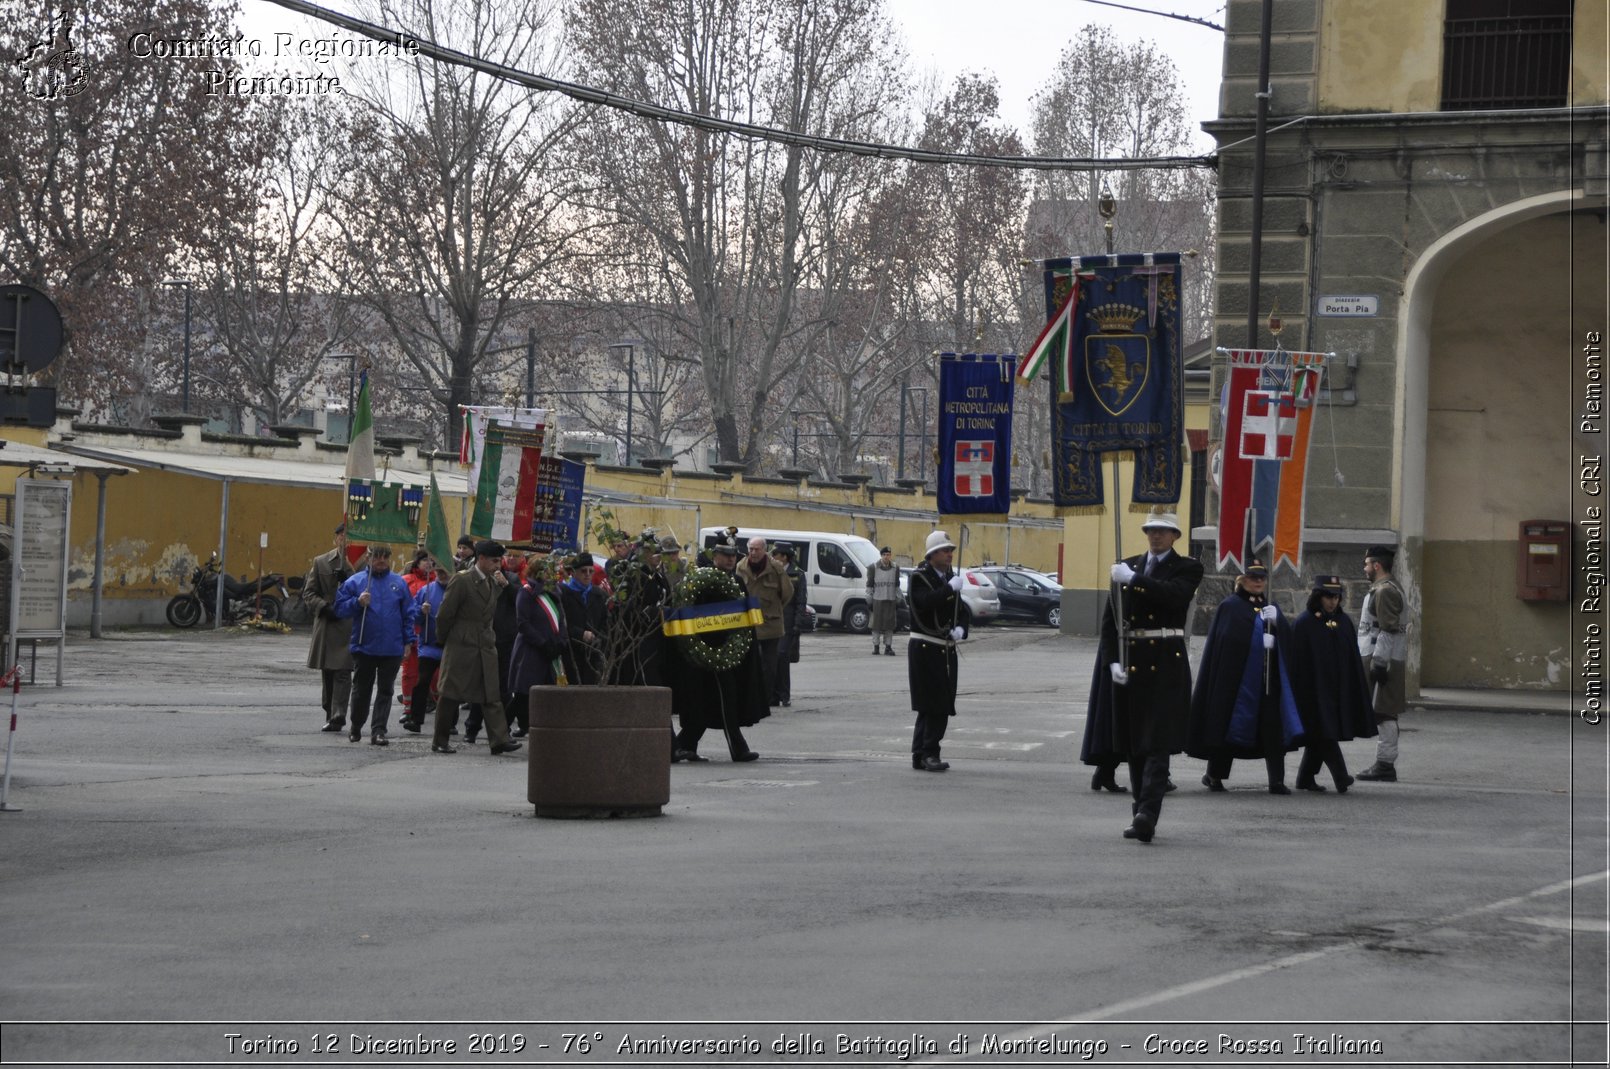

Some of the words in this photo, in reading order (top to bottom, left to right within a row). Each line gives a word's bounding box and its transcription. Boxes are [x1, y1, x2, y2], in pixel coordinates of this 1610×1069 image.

[1326, 305, 1350, 313] Porta
[1355, 305, 1369, 313] Pia
[966, 384, 989, 399] CITTÀ
[945, 401, 1010, 414] METROPOLITANA
[956, 417, 965, 430] DI
[968, 417, 996, 430] TORINO
[1108, 422, 1118, 435] DI
[1121, 421, 1163, 435] TORINO
